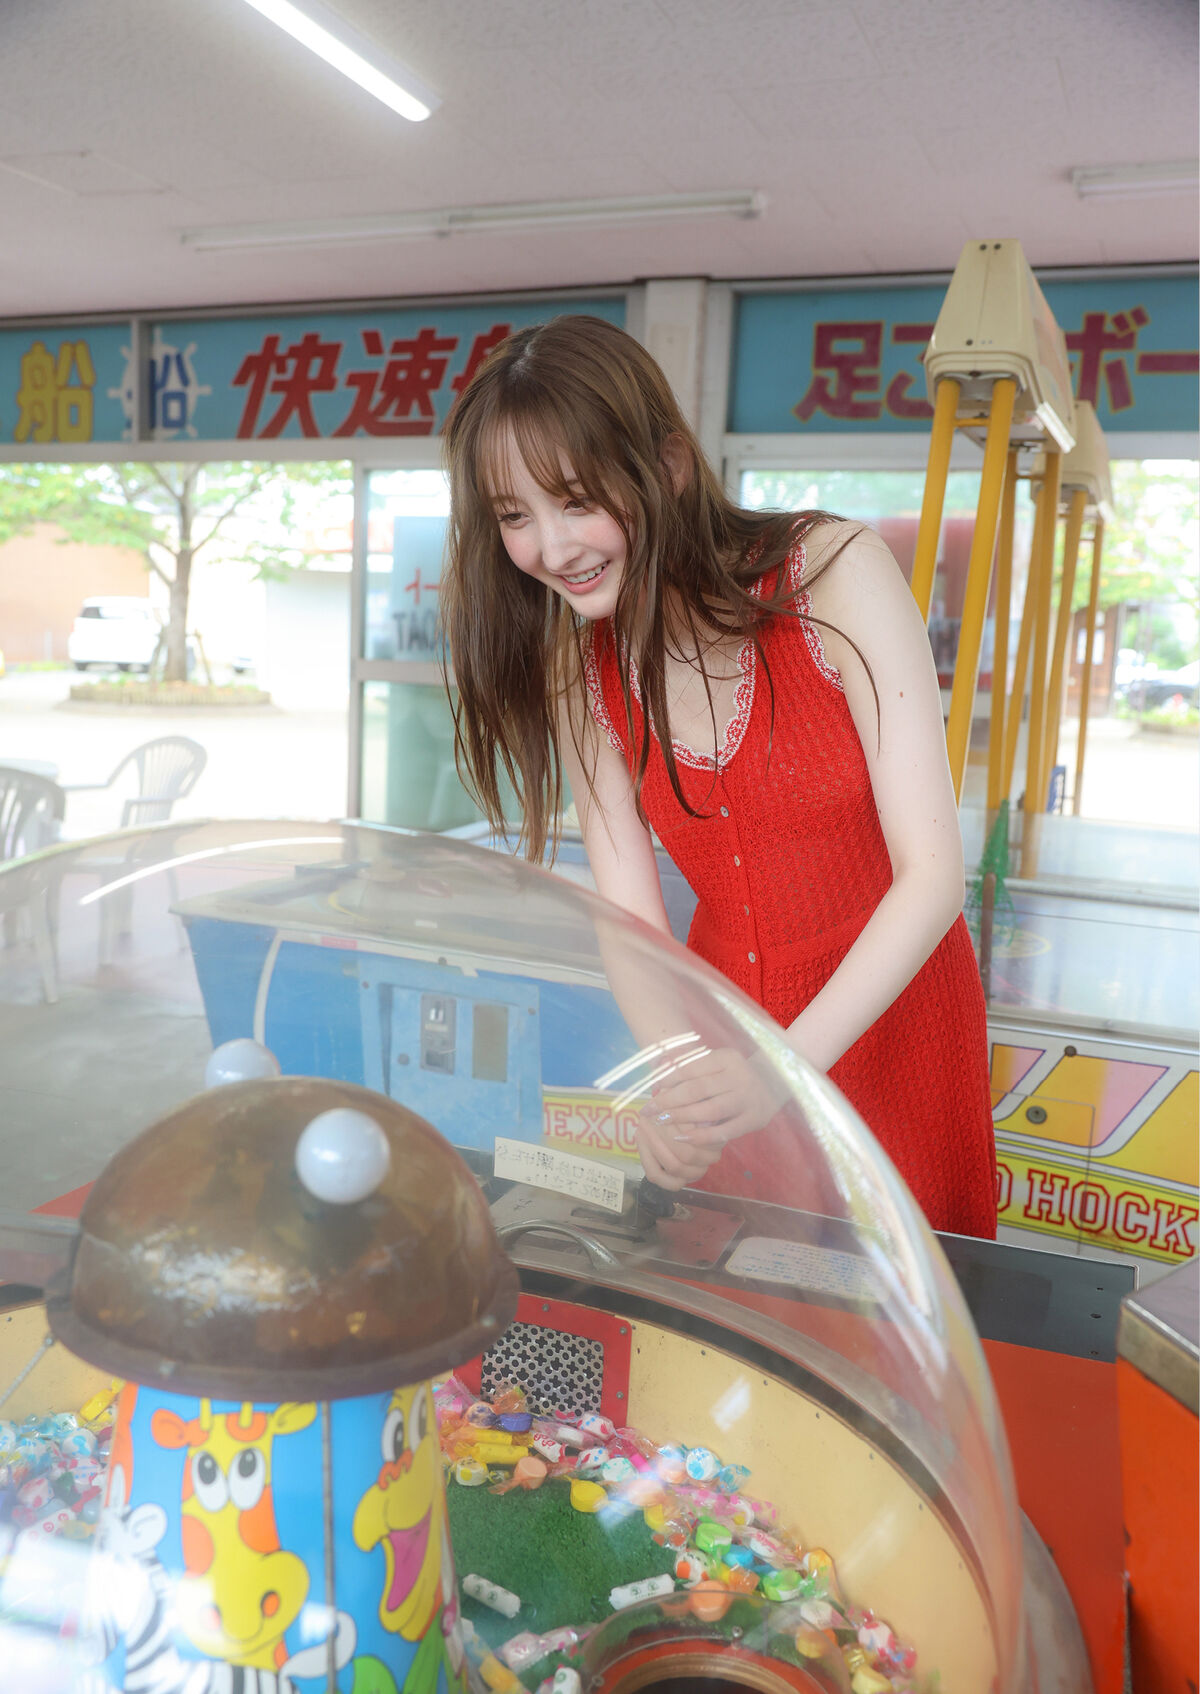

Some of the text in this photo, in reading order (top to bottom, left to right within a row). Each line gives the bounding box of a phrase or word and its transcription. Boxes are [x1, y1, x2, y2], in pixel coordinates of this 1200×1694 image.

[0, 339, 96, 442] 船
[231, 324, 512, 439] 快速
[793, 306, 1198, 421] 足こボー
[1023, 1168, 1199, 1257] HOCK
